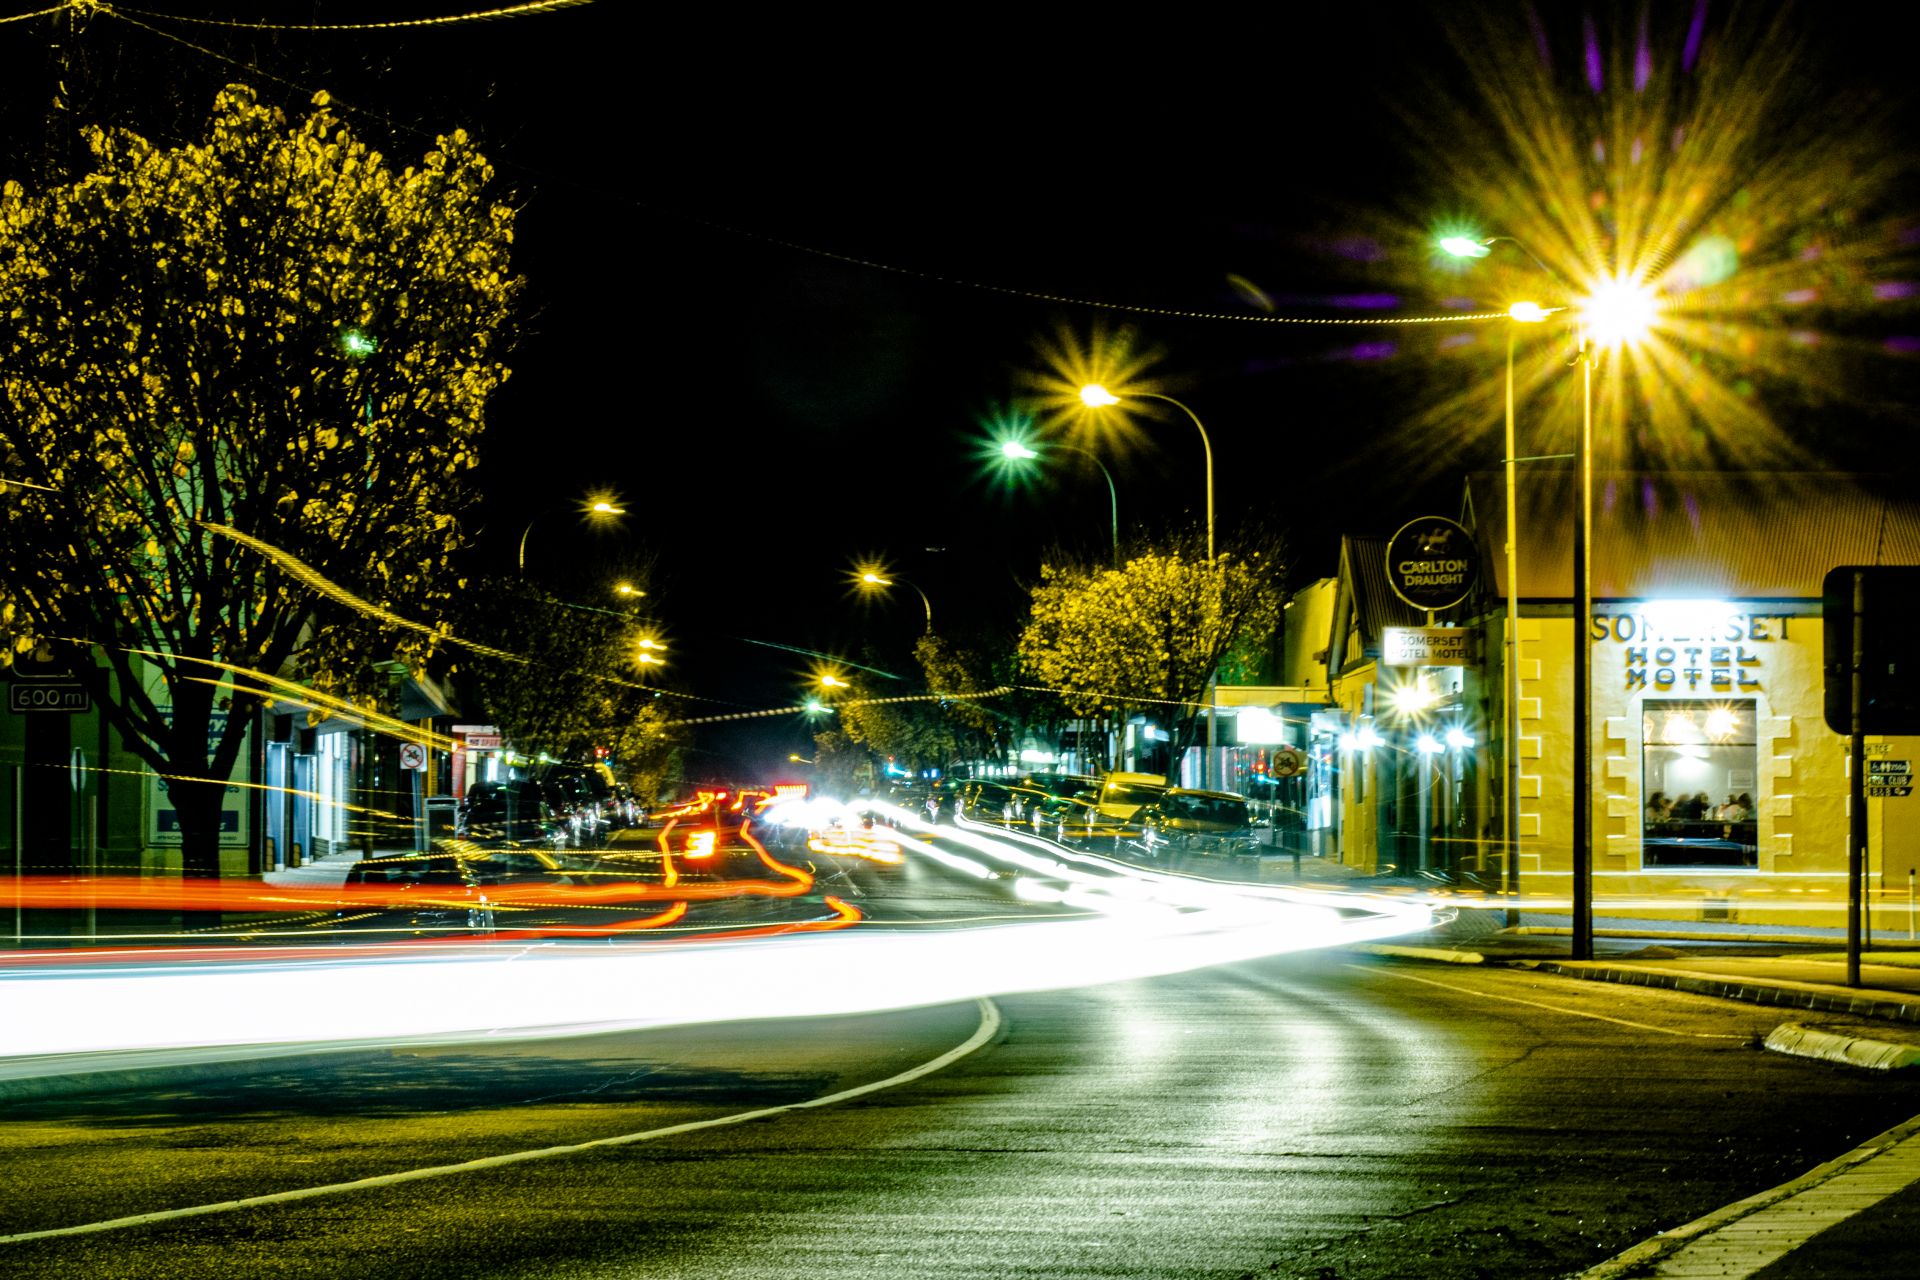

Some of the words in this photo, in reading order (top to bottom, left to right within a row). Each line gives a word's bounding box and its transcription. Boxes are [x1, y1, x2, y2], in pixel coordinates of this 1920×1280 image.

[1398, 560, 1468, 574] CARLTON
[1404, 574, 1464, 586] DRAUGHT
[1590, 614, 1796, 642] SOSET
[1432, 648, 1472, 659] MOTEL
[1628, 647, 1758, 663] HOTEL
[1628, 668, 1759, 685] MOTEL
[19, 690, 60, 705] 600
[65, 693, 82, 705] m
[1888, 775, 1908, 786] CLUB
